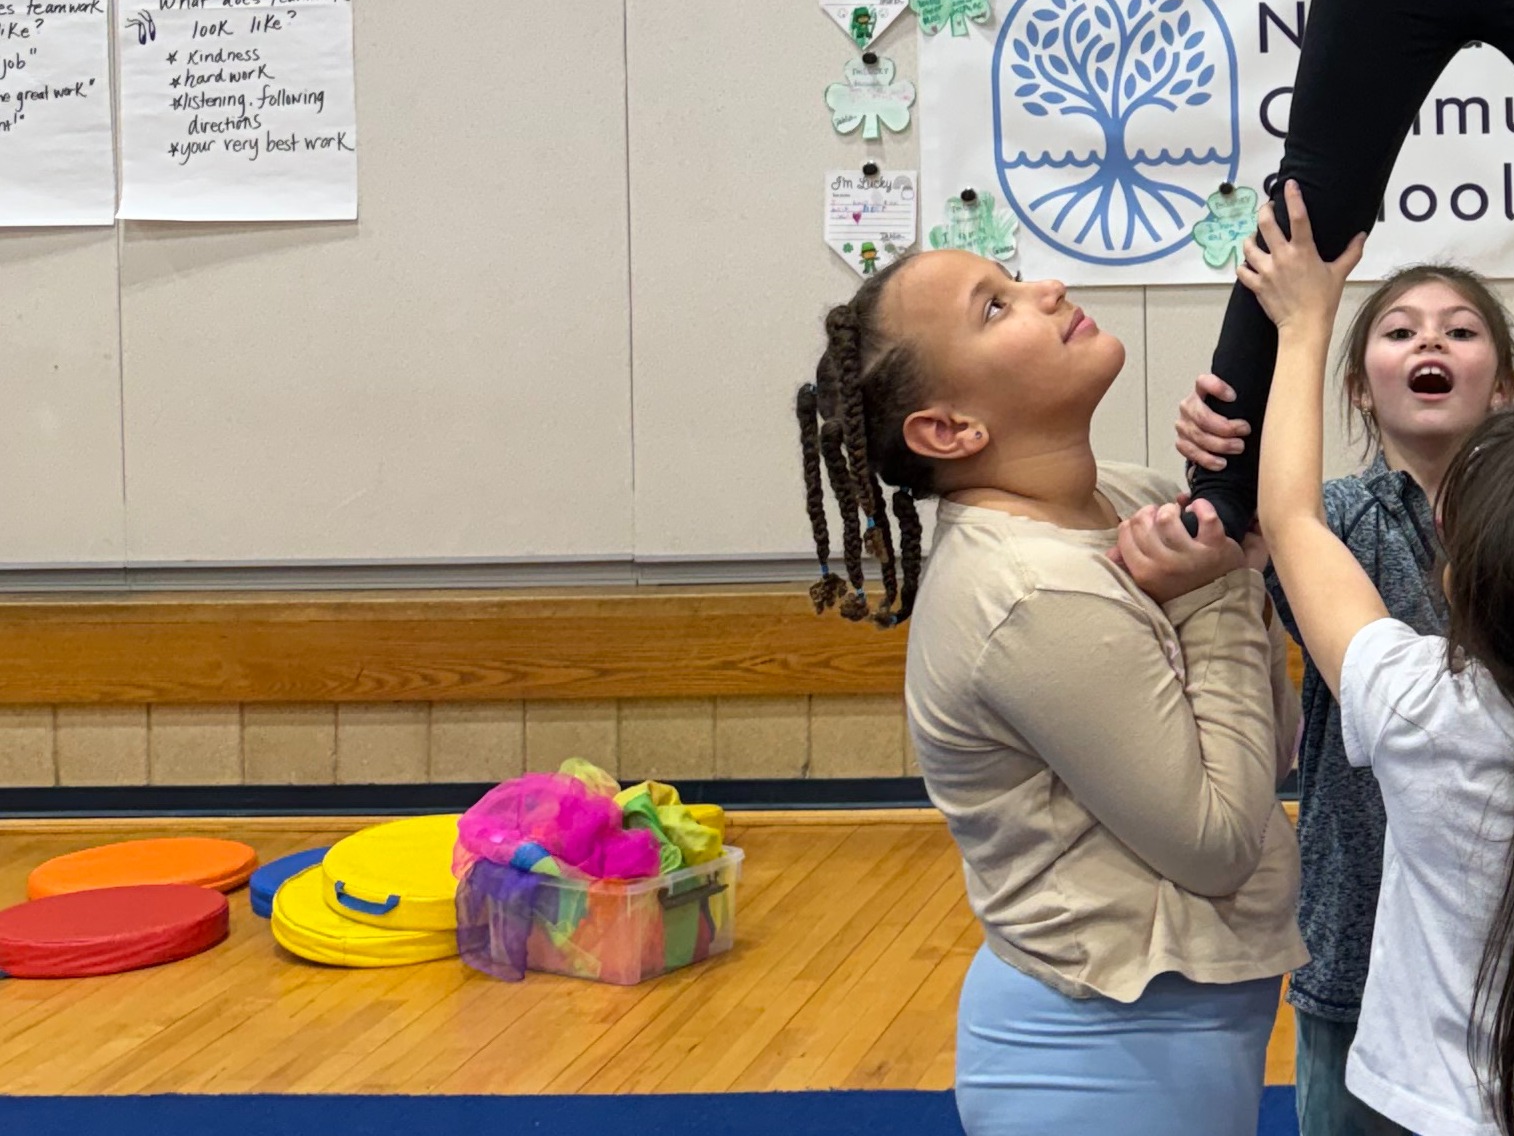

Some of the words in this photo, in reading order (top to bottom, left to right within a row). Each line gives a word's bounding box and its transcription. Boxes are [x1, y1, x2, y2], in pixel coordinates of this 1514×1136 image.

[0, 4, 15, 15] es
[0, 18, 44, 39] ike?
[16, 85, 48, 113] great
[258, 84, 325, 114] following
[188, 115, 262, 135] directions
[180, 140, 216, 165] your
[224, 141, 260, 162] very
[266, 130, 299, 152] best
[305, 131, 355, 152] work
[857, 176, 892, 193] Lucky
